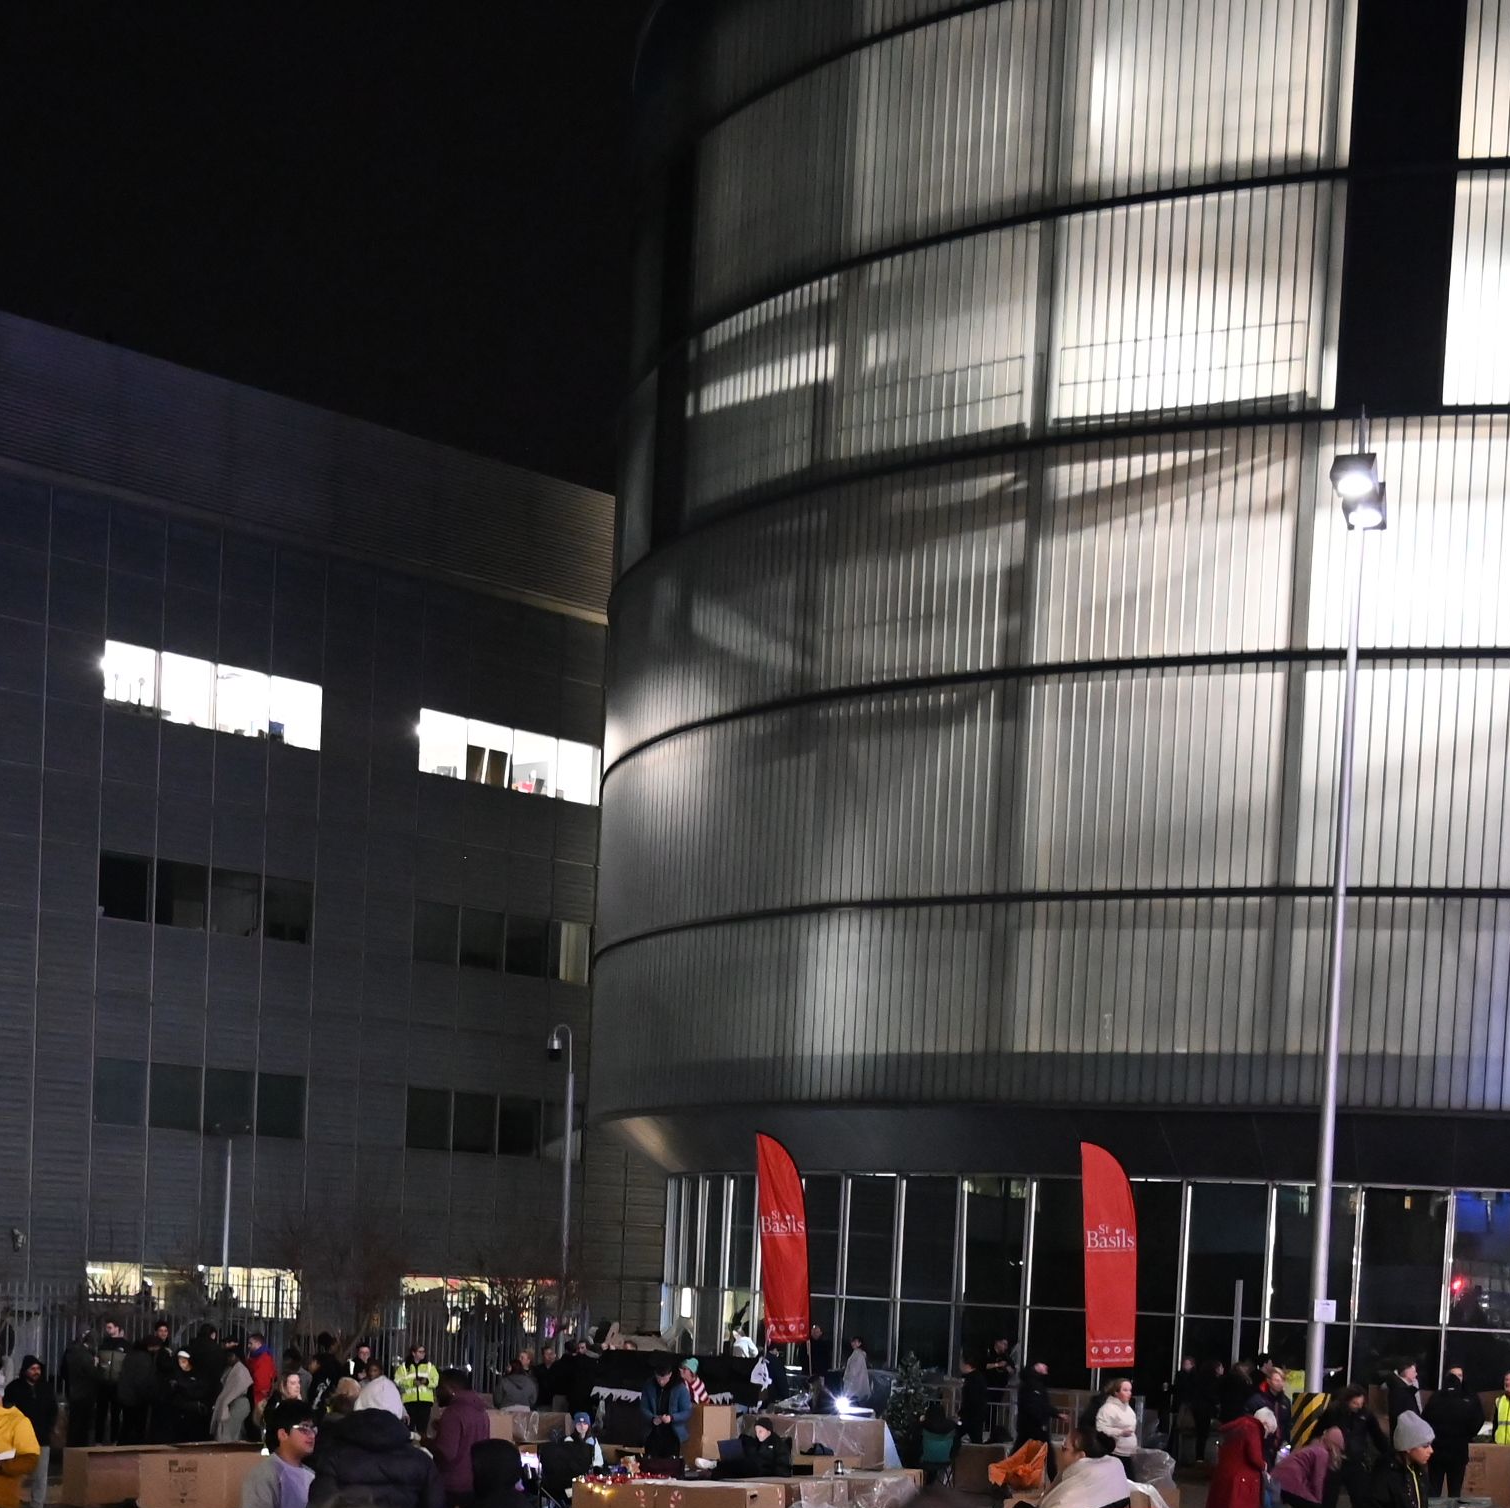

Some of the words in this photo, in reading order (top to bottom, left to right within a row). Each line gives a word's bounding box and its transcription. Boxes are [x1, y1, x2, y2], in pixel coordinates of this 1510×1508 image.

[771, 1210, 780, 1220] St
[761, 1215, 805, 1233] Basils
[1098, 1223, 1109, 1235] St
[1086, 1228, 1136, 1248] Basils
